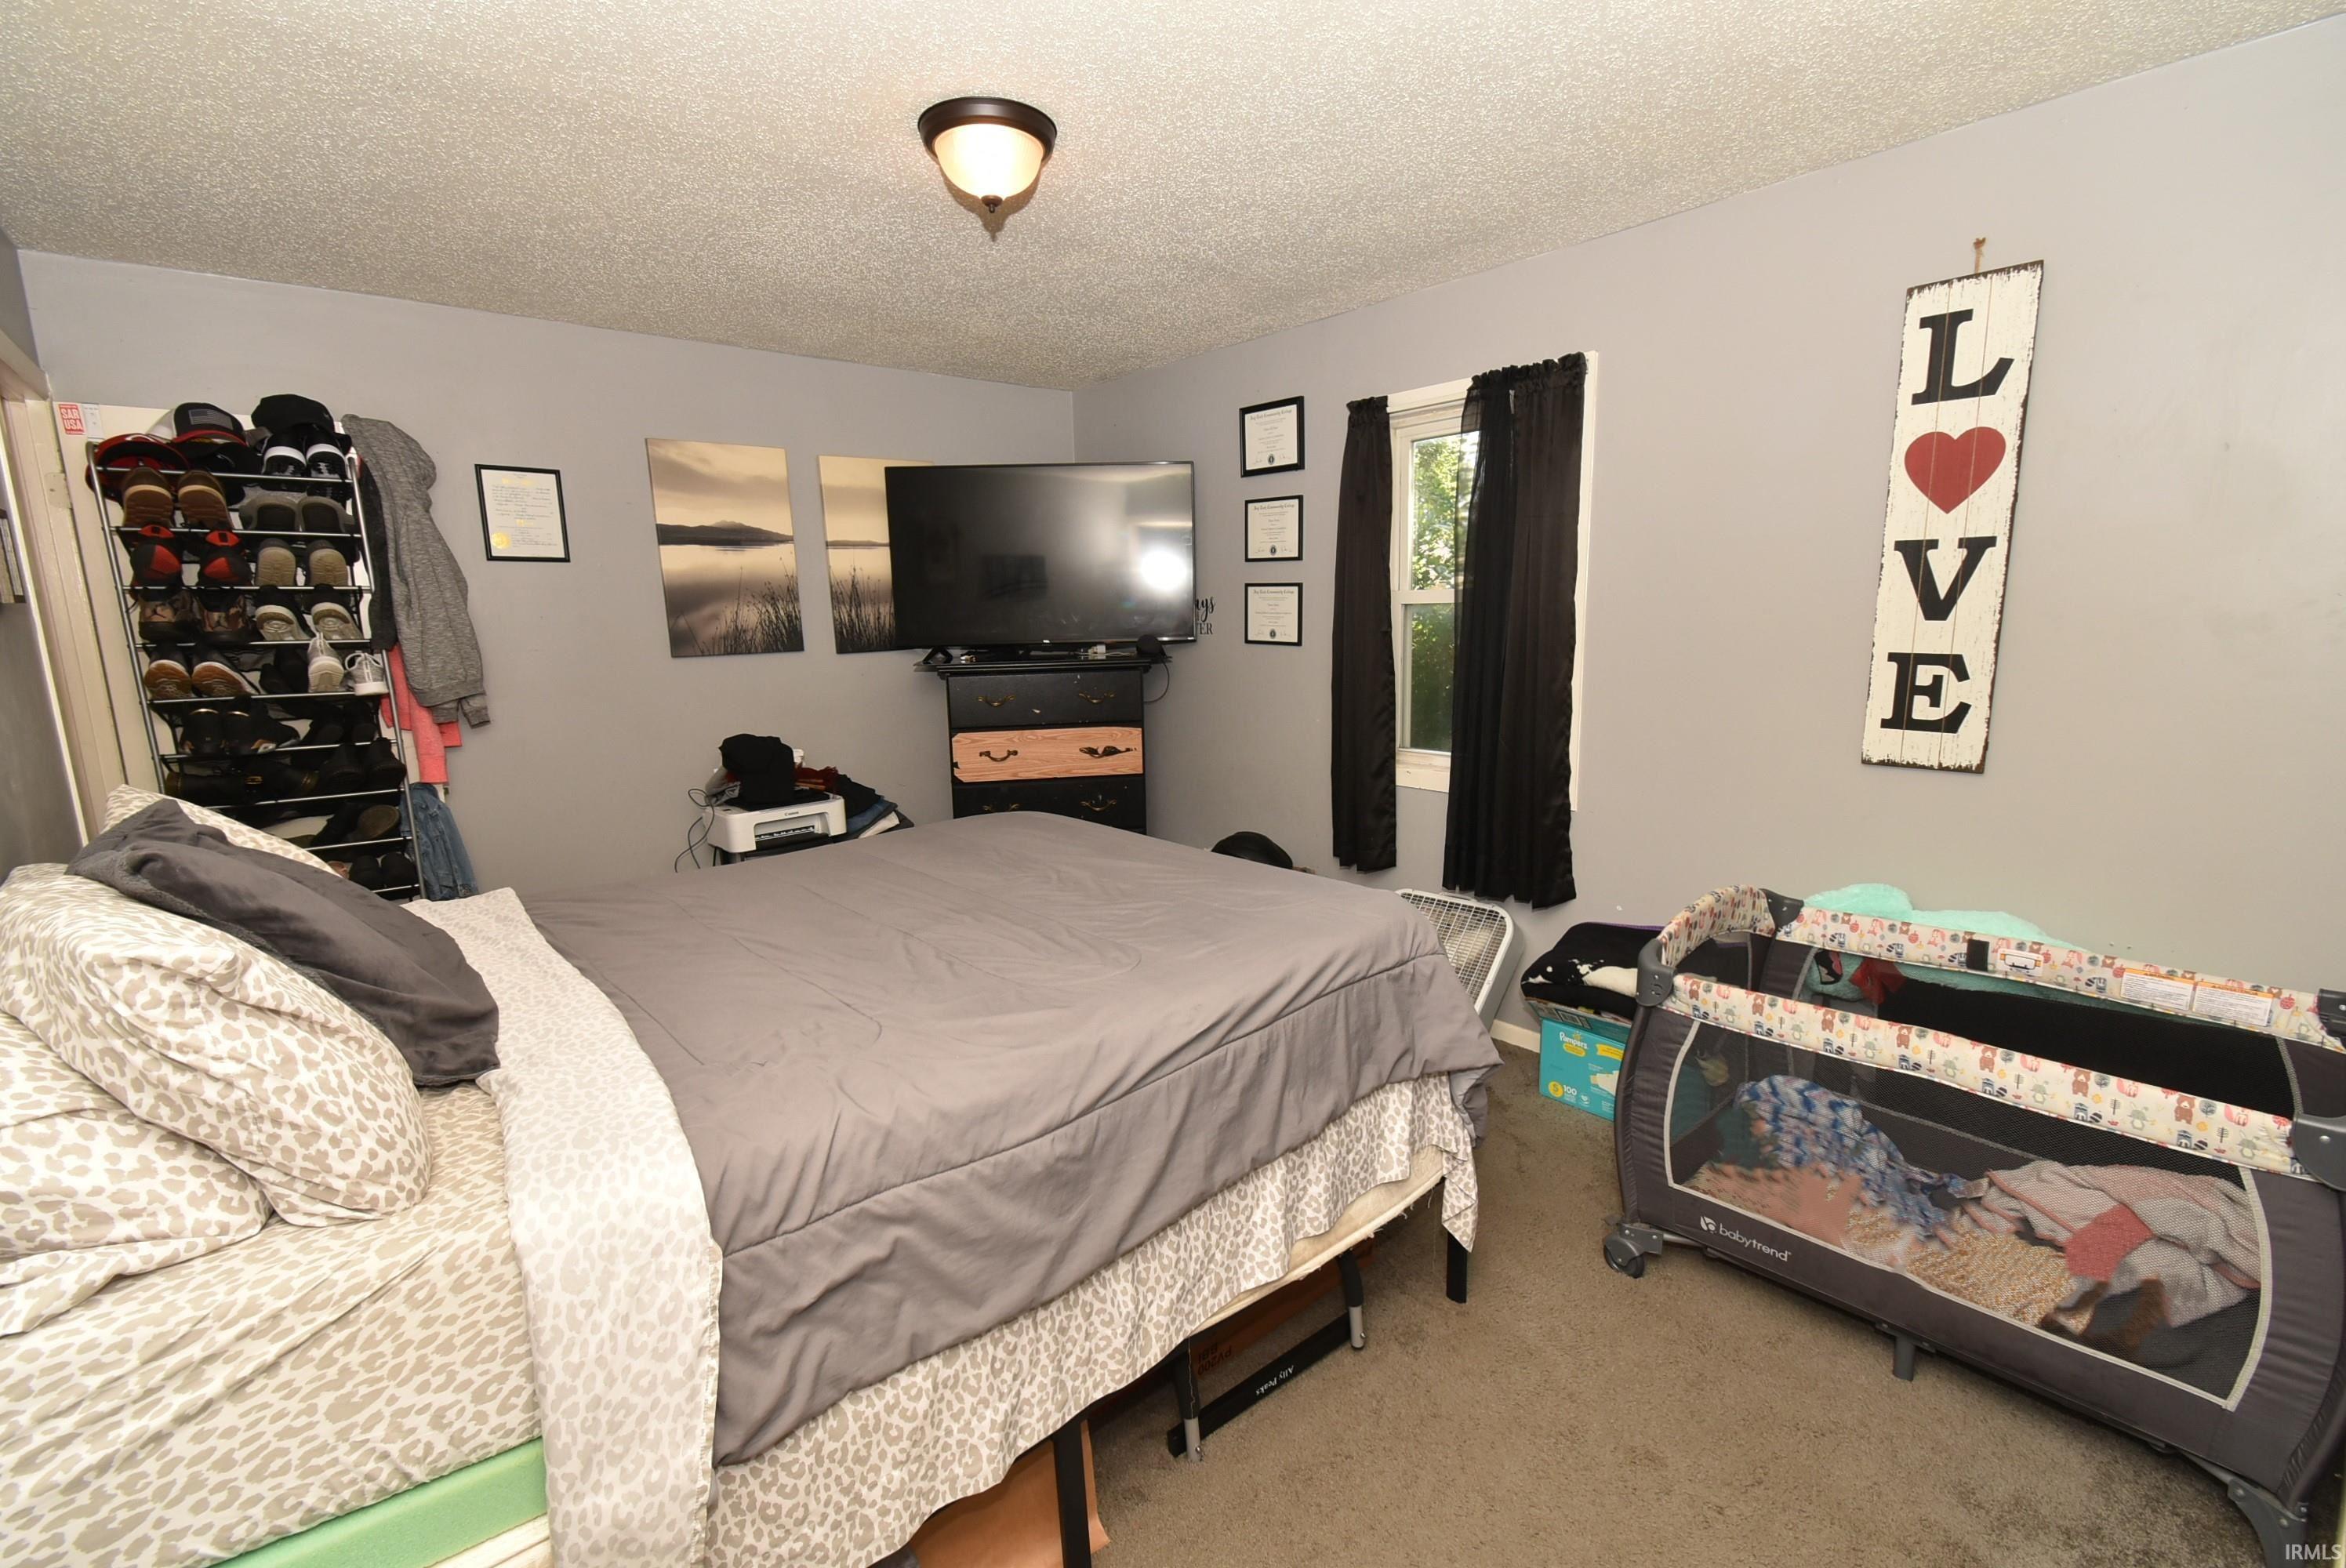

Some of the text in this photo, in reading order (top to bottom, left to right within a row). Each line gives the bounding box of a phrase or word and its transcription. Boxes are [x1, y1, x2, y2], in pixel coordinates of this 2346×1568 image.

[60, 408, 80, 419] SAR
[64, 419, 83, 430] USA
[1559, 1031, 1589, 1050] Pampers
[1563, 1084, 1578, 1096] 100
